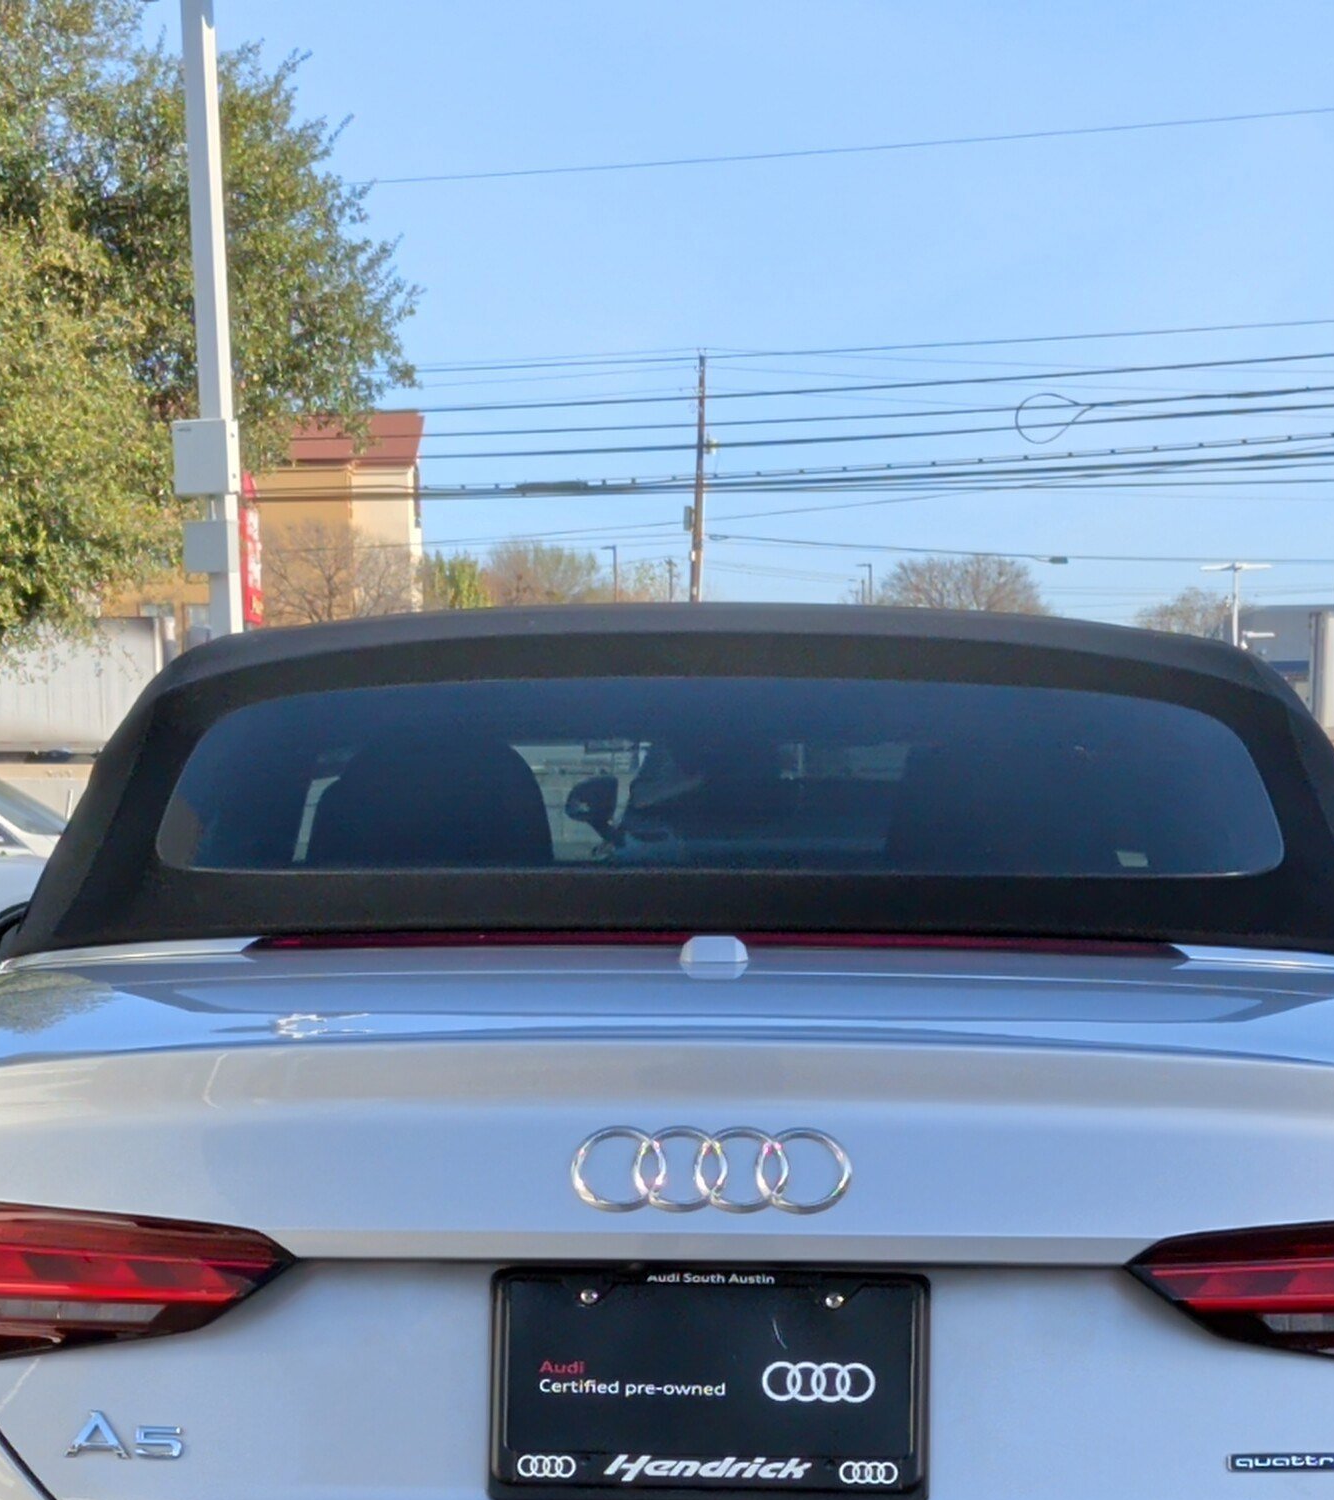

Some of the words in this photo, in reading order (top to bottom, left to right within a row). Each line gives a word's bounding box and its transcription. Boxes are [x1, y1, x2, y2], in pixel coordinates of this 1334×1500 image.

[647, 1273, 681, 1283] Audi
[682, 1273, 726, 1284] South
[727, 1273, 776, 1285] Austin
[539, 1361, 585, 1374] Audi
[539, 1378, 619, 1394] Certified
[624, 1382, 727, 1397] pre-owned
[65, 1409, 184, 1461] A5
[603, 1454, 813, 1482] Hendrick
